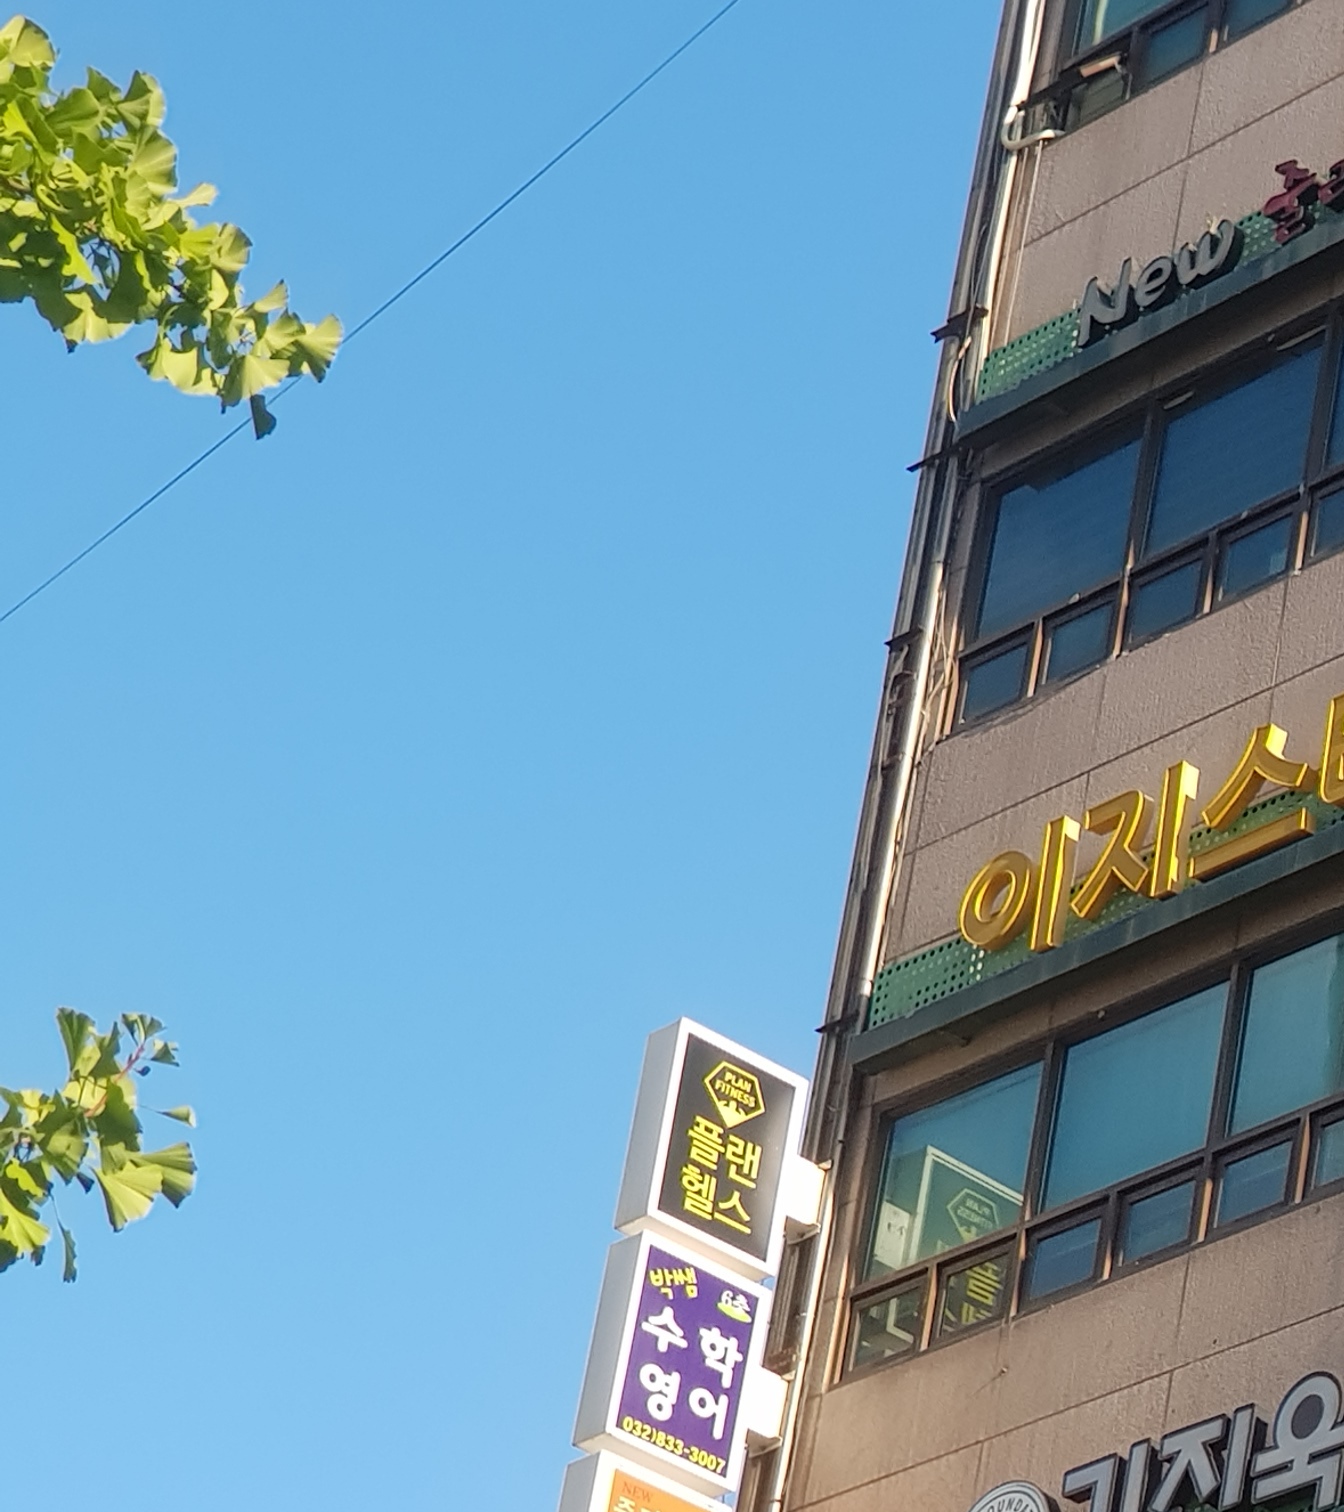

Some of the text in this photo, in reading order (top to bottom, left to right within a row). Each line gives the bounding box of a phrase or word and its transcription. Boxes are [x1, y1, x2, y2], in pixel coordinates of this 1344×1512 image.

[1076, 213, 1237, 345] New
[724, 1071, 752, 1093] PLAN
[686, 1114, 763, 1189] 플랜
[680, 1165, 752, 1234] 헬스
[641, 1306, 744, 1389] 수학
[638, 1363, 730, 1440] 영어
